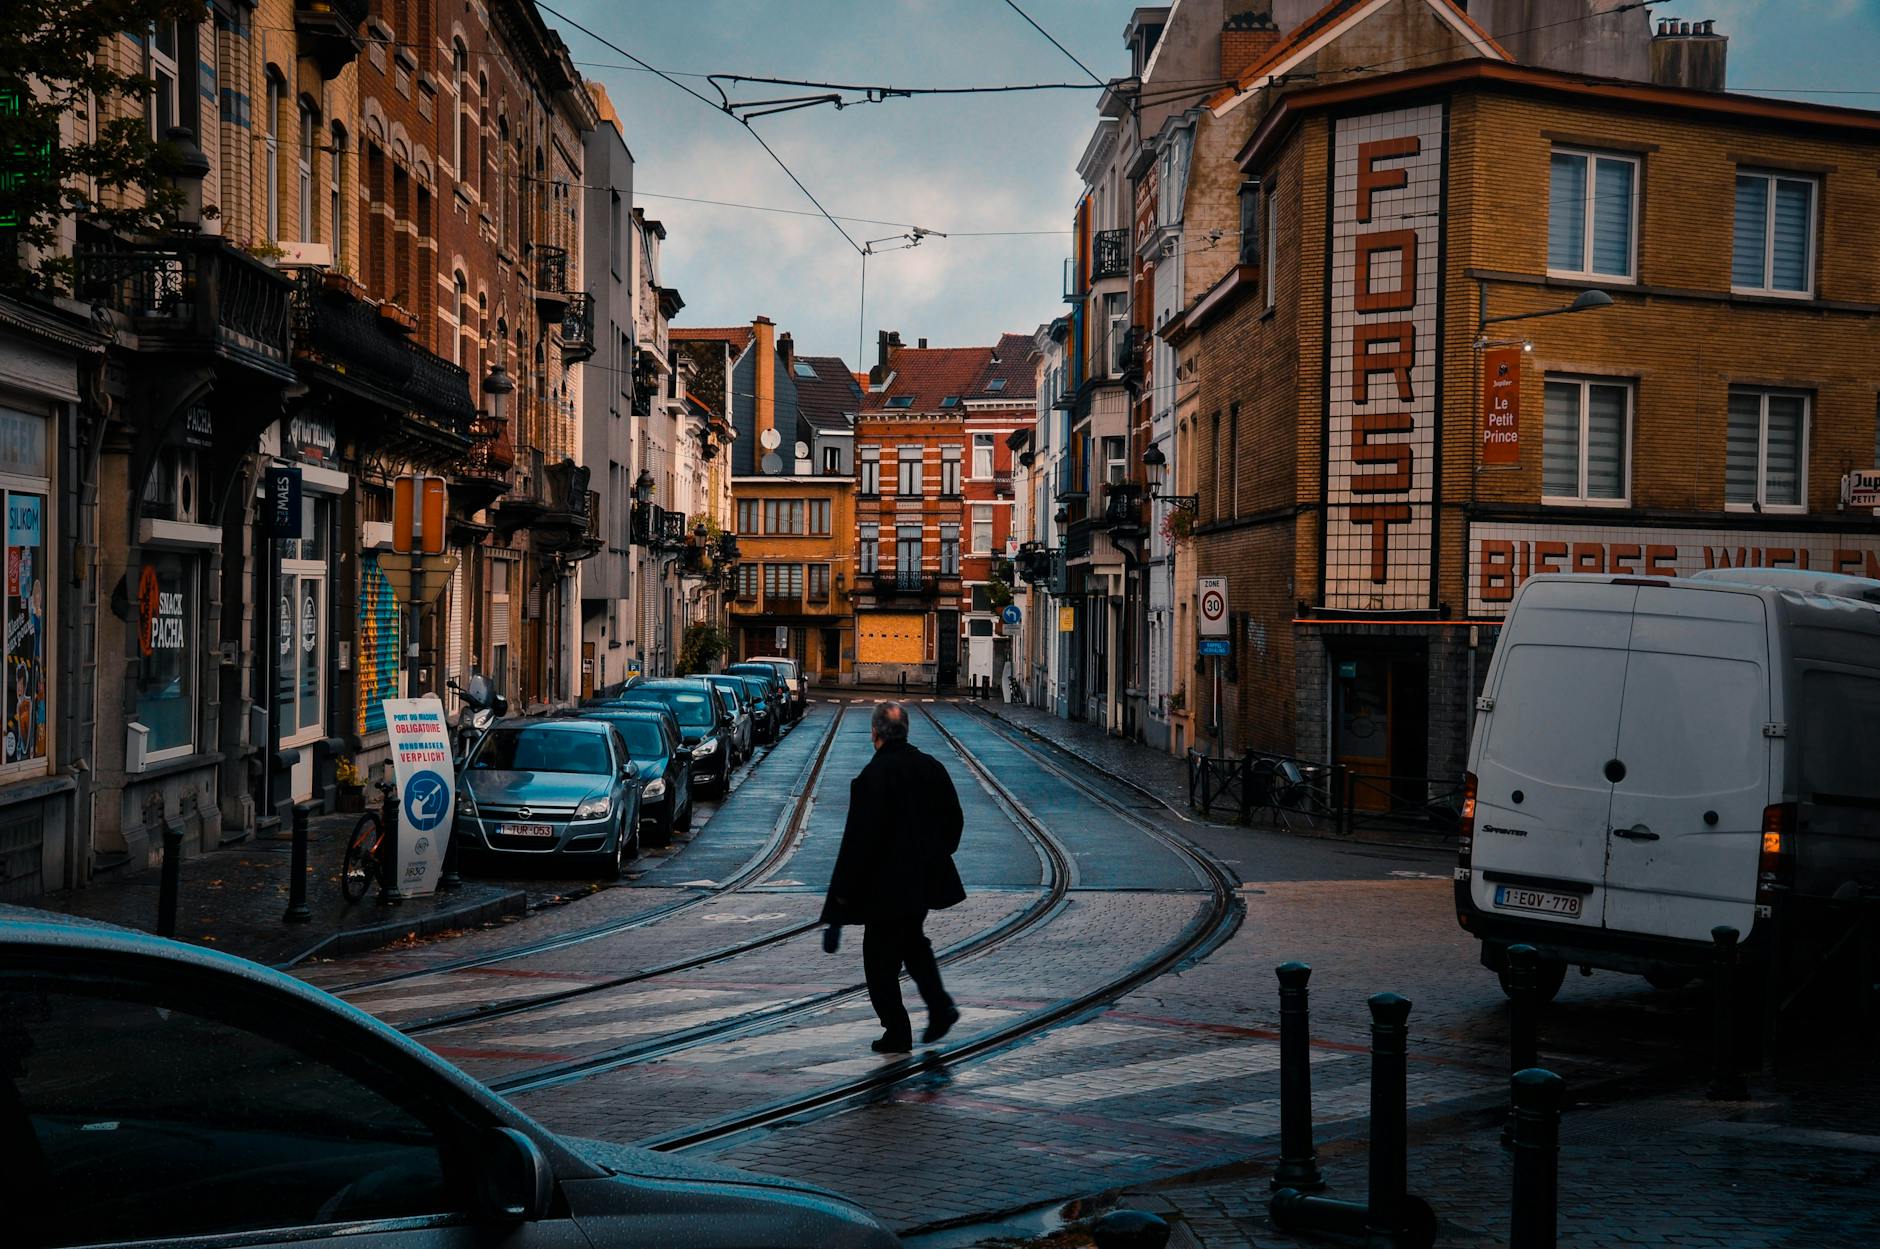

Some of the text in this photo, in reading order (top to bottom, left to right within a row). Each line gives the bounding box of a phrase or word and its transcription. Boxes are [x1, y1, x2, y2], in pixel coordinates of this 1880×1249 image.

[1350, 136, 1420, 584] FORST
[1495, 397, 1508, 409] Le
[1489, 413, 1514, 426] Petit
[1484, 430, 1518, 443] Prince
[277, 476, 289, 511] MAES
[1851, 495, 1876, 503] PETIT
[159, 592, 183, 615] SNACK
[1207, 600, 1219, 611] 30
[151, 617, 184, 648] PACHA
[419, 713, 438, 721] MASQUE
[396, 723, 441, 734] OBLIGATOIRE
[400, 752, 445, 763] VERPLICHT
